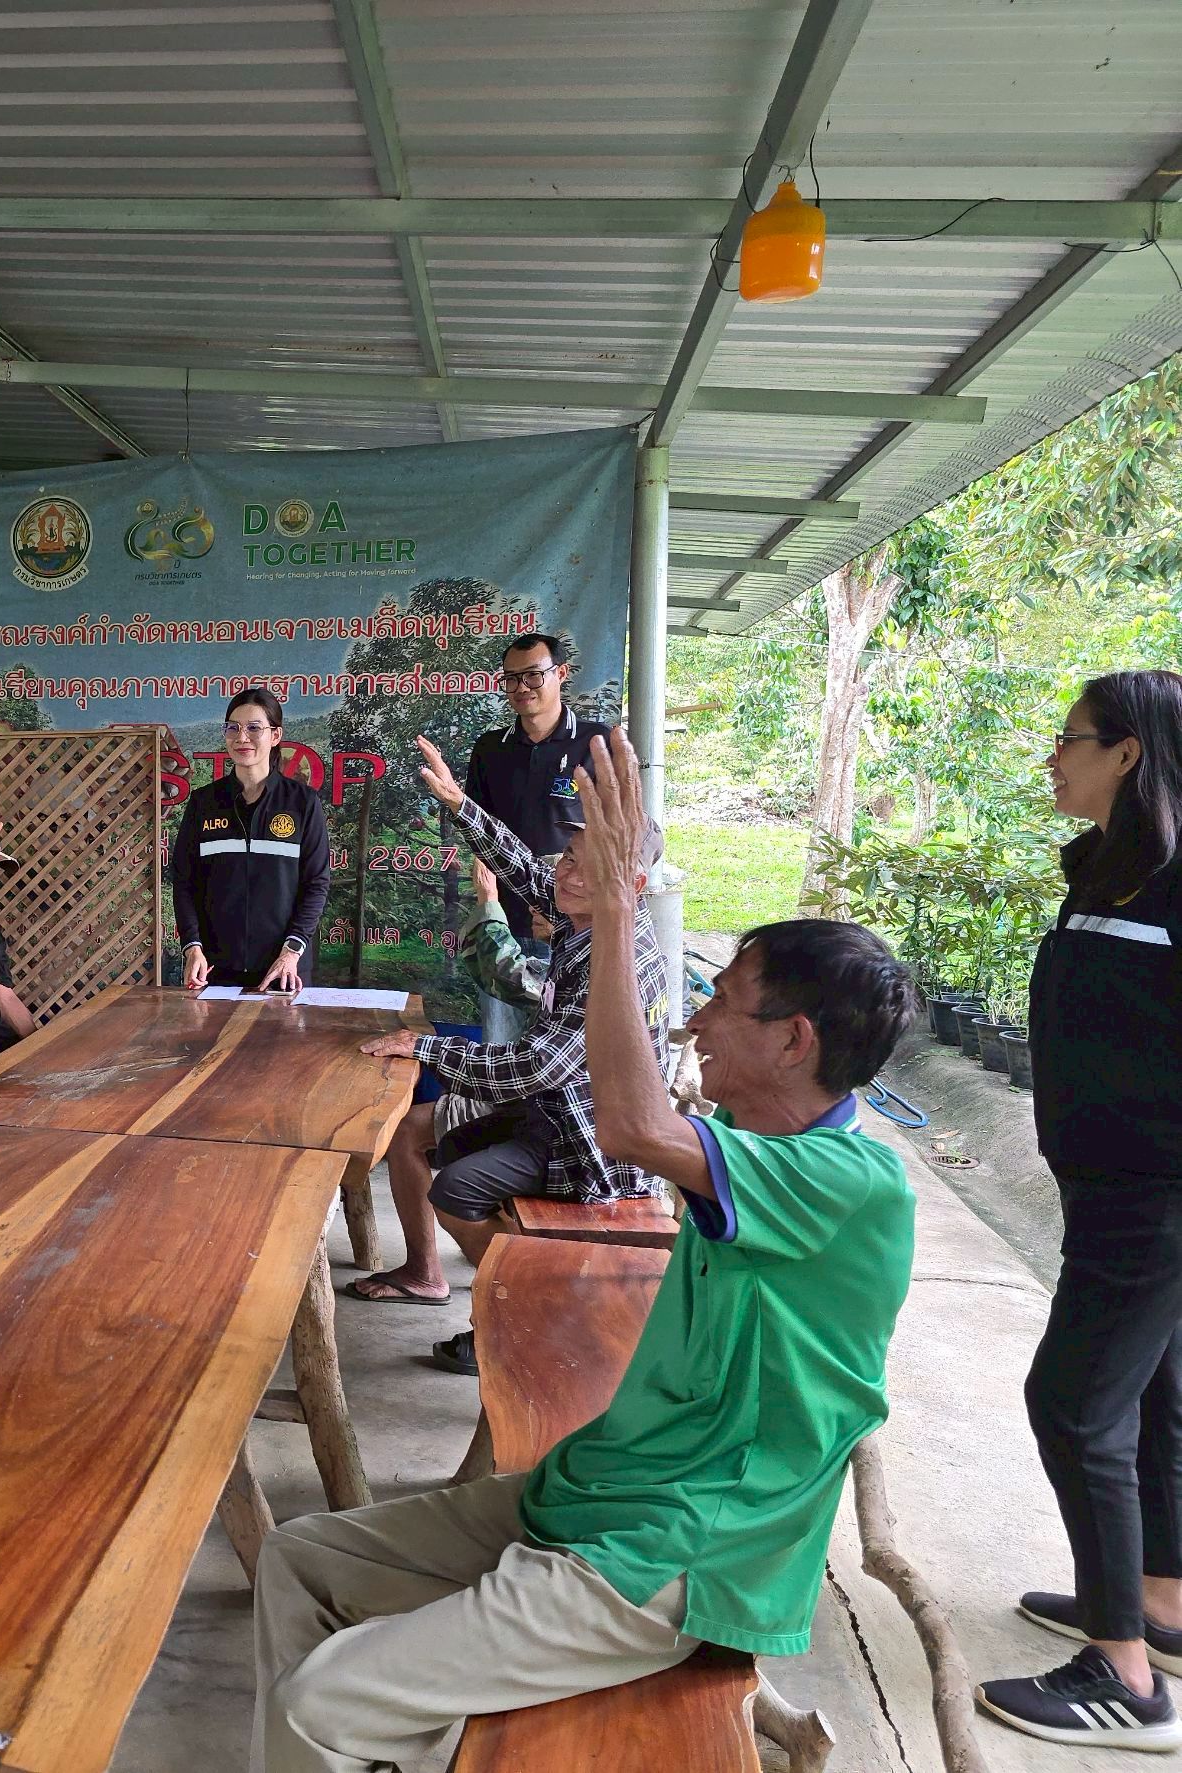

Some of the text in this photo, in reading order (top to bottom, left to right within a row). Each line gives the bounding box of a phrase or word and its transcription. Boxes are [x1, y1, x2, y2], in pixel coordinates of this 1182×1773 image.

[243, 538, 417, 567] TOGETHER
[14, 567, 87, 589] กรมวิชาการเกษตร
[247, 573, 273, 581] Hearing
[203, 818, 229, 831] ALRO
[368, 846, 459, 871] 2567
[319, 918, 401, 944] .ลัแล
